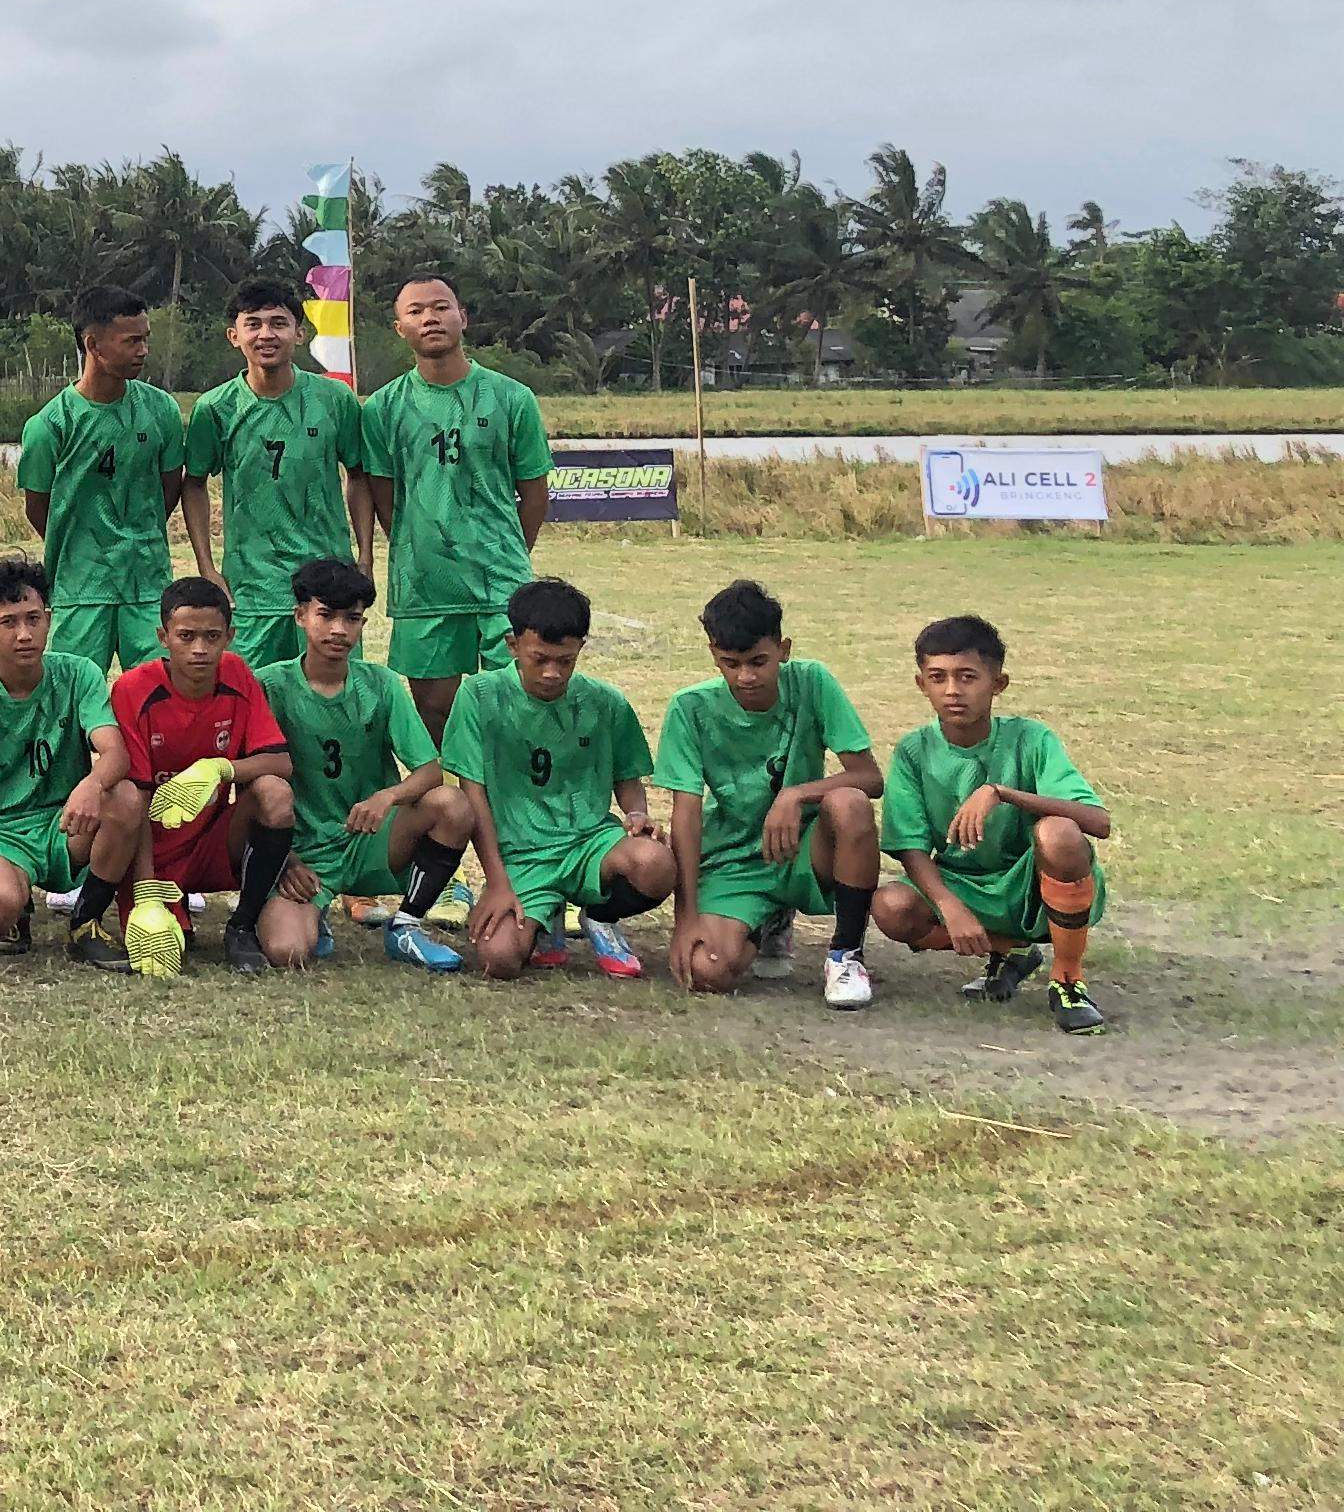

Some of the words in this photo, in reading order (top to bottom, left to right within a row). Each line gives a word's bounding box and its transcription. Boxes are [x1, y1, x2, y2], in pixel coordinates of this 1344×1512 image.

[98, 445, 116, 479] 4
[266, 440, 286, 480] 7
[431, 428, 461, 465] 13
[547, 464, 672, 491] NCASONA
[983, 472, 1016, 486] ALI
[1024, 472, 1078, 487] CELL
[1084, 472, 1097, 487] 2
[24, 738, 54, 778] 10
[323, 738, 343, 779] 3
[531, 747, 552, 787] 9
